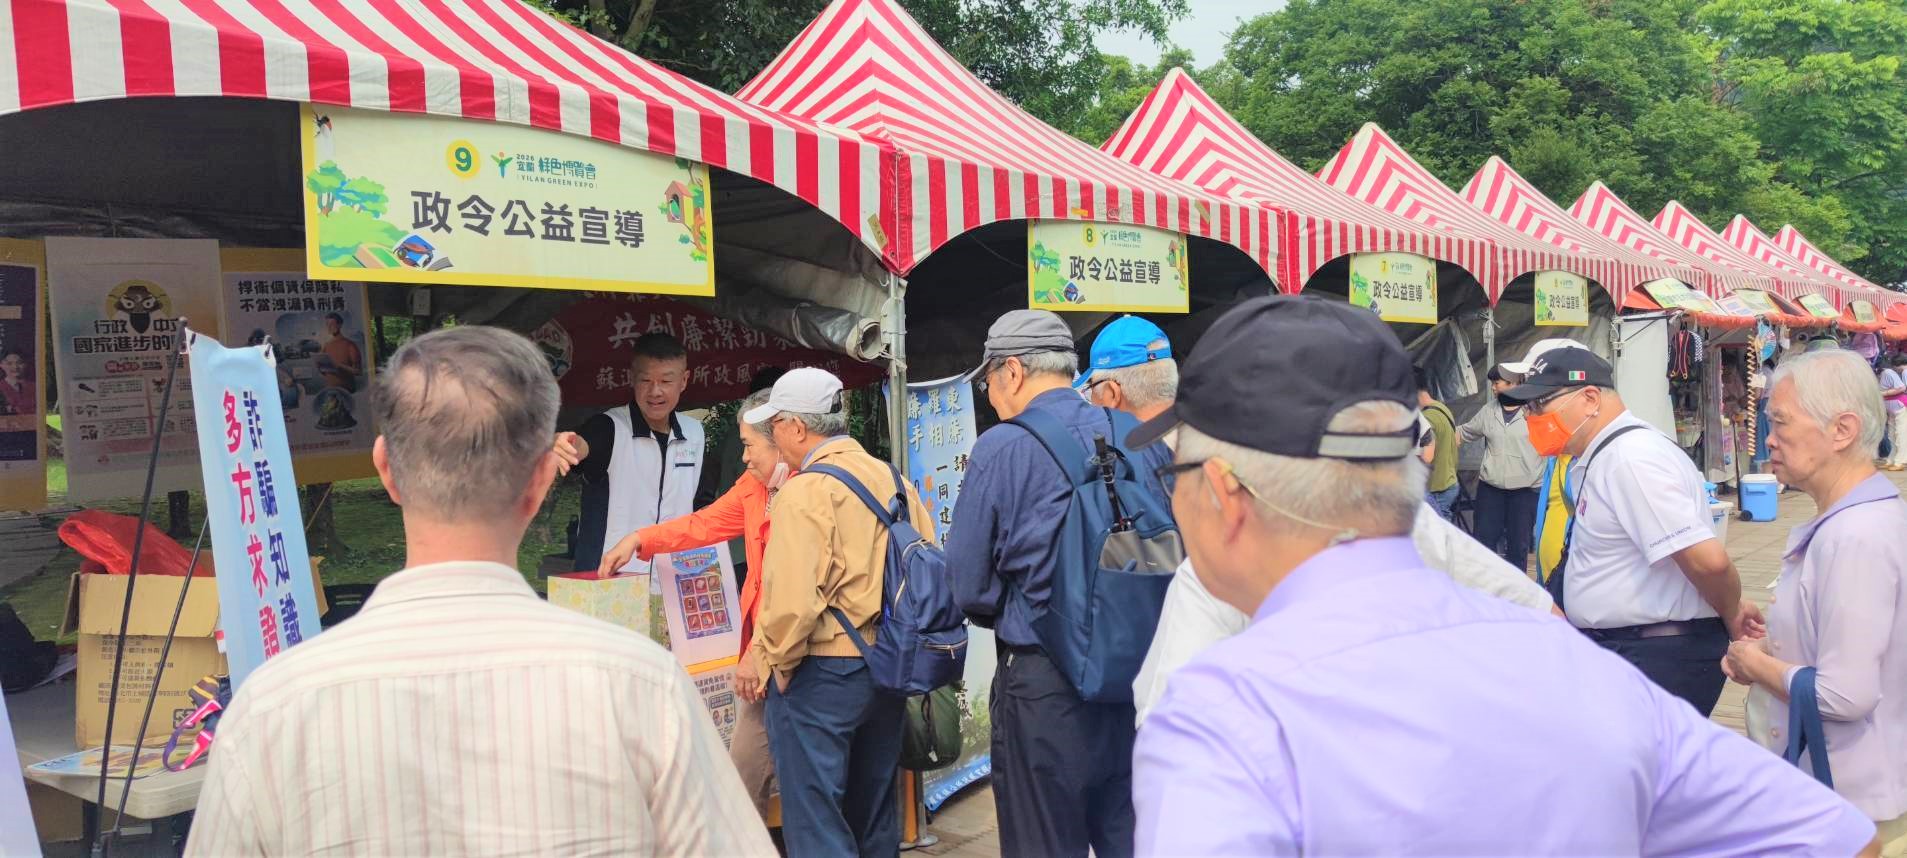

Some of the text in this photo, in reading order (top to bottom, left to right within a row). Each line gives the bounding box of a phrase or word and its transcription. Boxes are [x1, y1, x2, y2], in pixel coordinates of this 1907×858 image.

[454, 147, 472, 173] 9
[516, 153, 535, 162] 2026
[516, 156, 596, 180] 宜蘭 綠色博覽會
[521, 176, 594, 189] YILAN GREEN EXPO
[410, 190, 645, 249] 政令公益宣導
[1086, 228, 1093, 243] 8
[1069, 255, 1161, 285] 政令公益宣導
[238, 280, 345, 295] 捍衛個資保隱私
[1372, 280, 1423, 303] 政令公益宣導
[240, 297, 346, 312] 不當洩漏負刑責
[94, 319, 128, 334] 行政
[74, 335, 176, 354] 國家進步的
